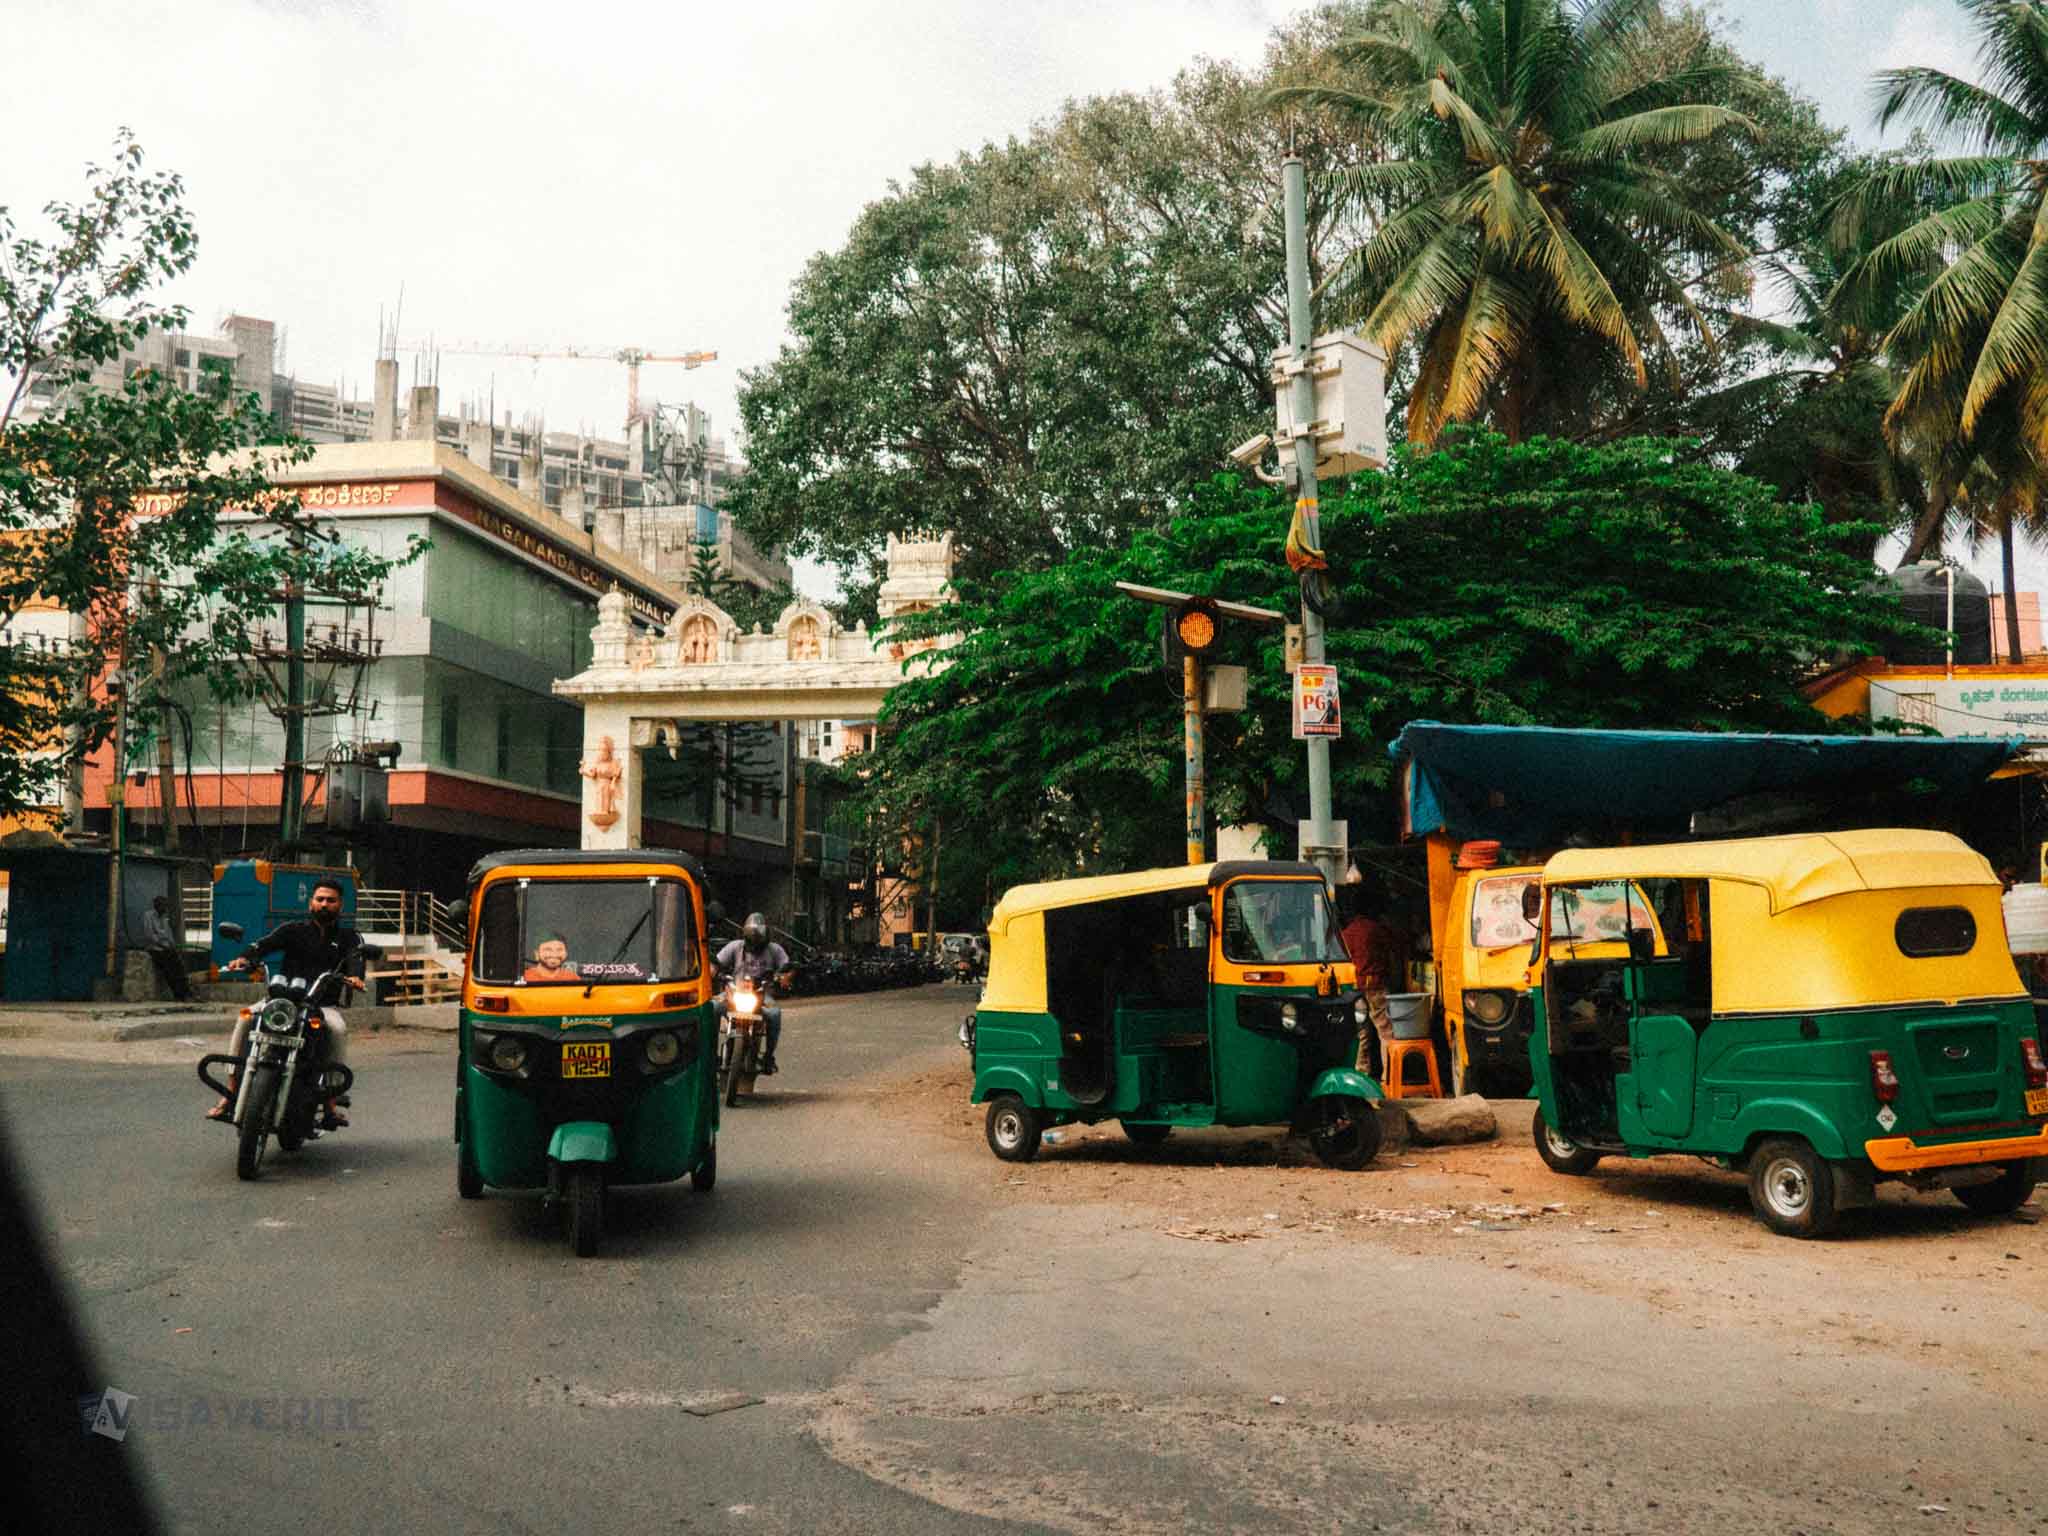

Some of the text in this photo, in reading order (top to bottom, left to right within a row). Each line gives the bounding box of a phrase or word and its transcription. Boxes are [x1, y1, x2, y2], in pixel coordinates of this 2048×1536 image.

[477, 509, 577, 577] NAGANANDA
[580, 566, 661, 620] CORCIAL
[1302, 694, 1327, 712] PG
[567, 1045, 606, 1058] KA01
